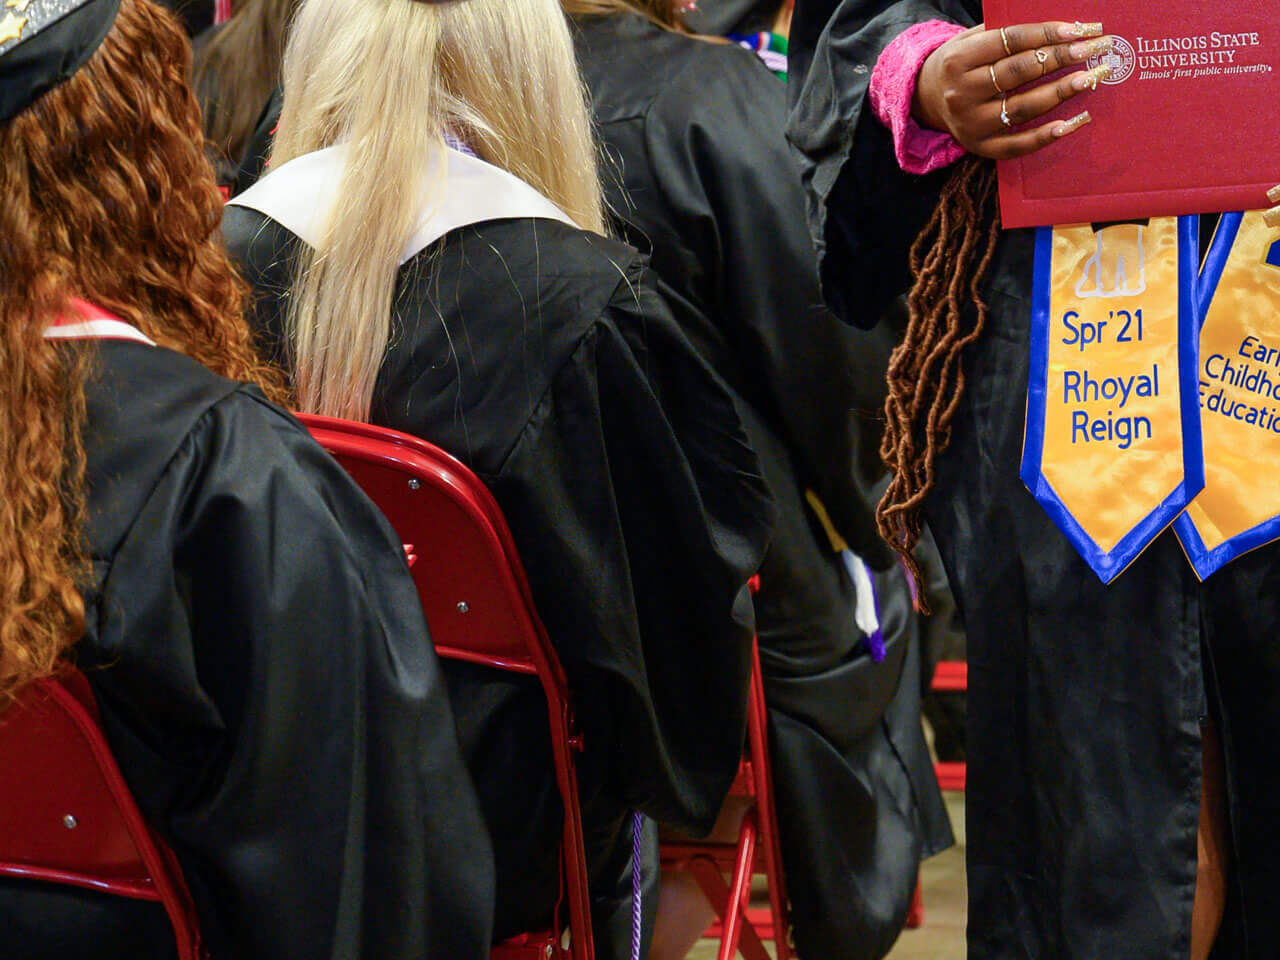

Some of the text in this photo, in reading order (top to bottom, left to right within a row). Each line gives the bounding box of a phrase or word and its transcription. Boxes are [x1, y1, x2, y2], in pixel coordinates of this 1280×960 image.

[1136, 32, 1260, 53] ILLINOIS STATE
[1138, 50, 1236, 69] UNIVERSITY
[1172, 67, 1192, 80] first
[1193, 65, 1222, 79] public
[1063, 364, 1159, 407] Rhoyal
[1071, 410, 1152, 449] Reign
